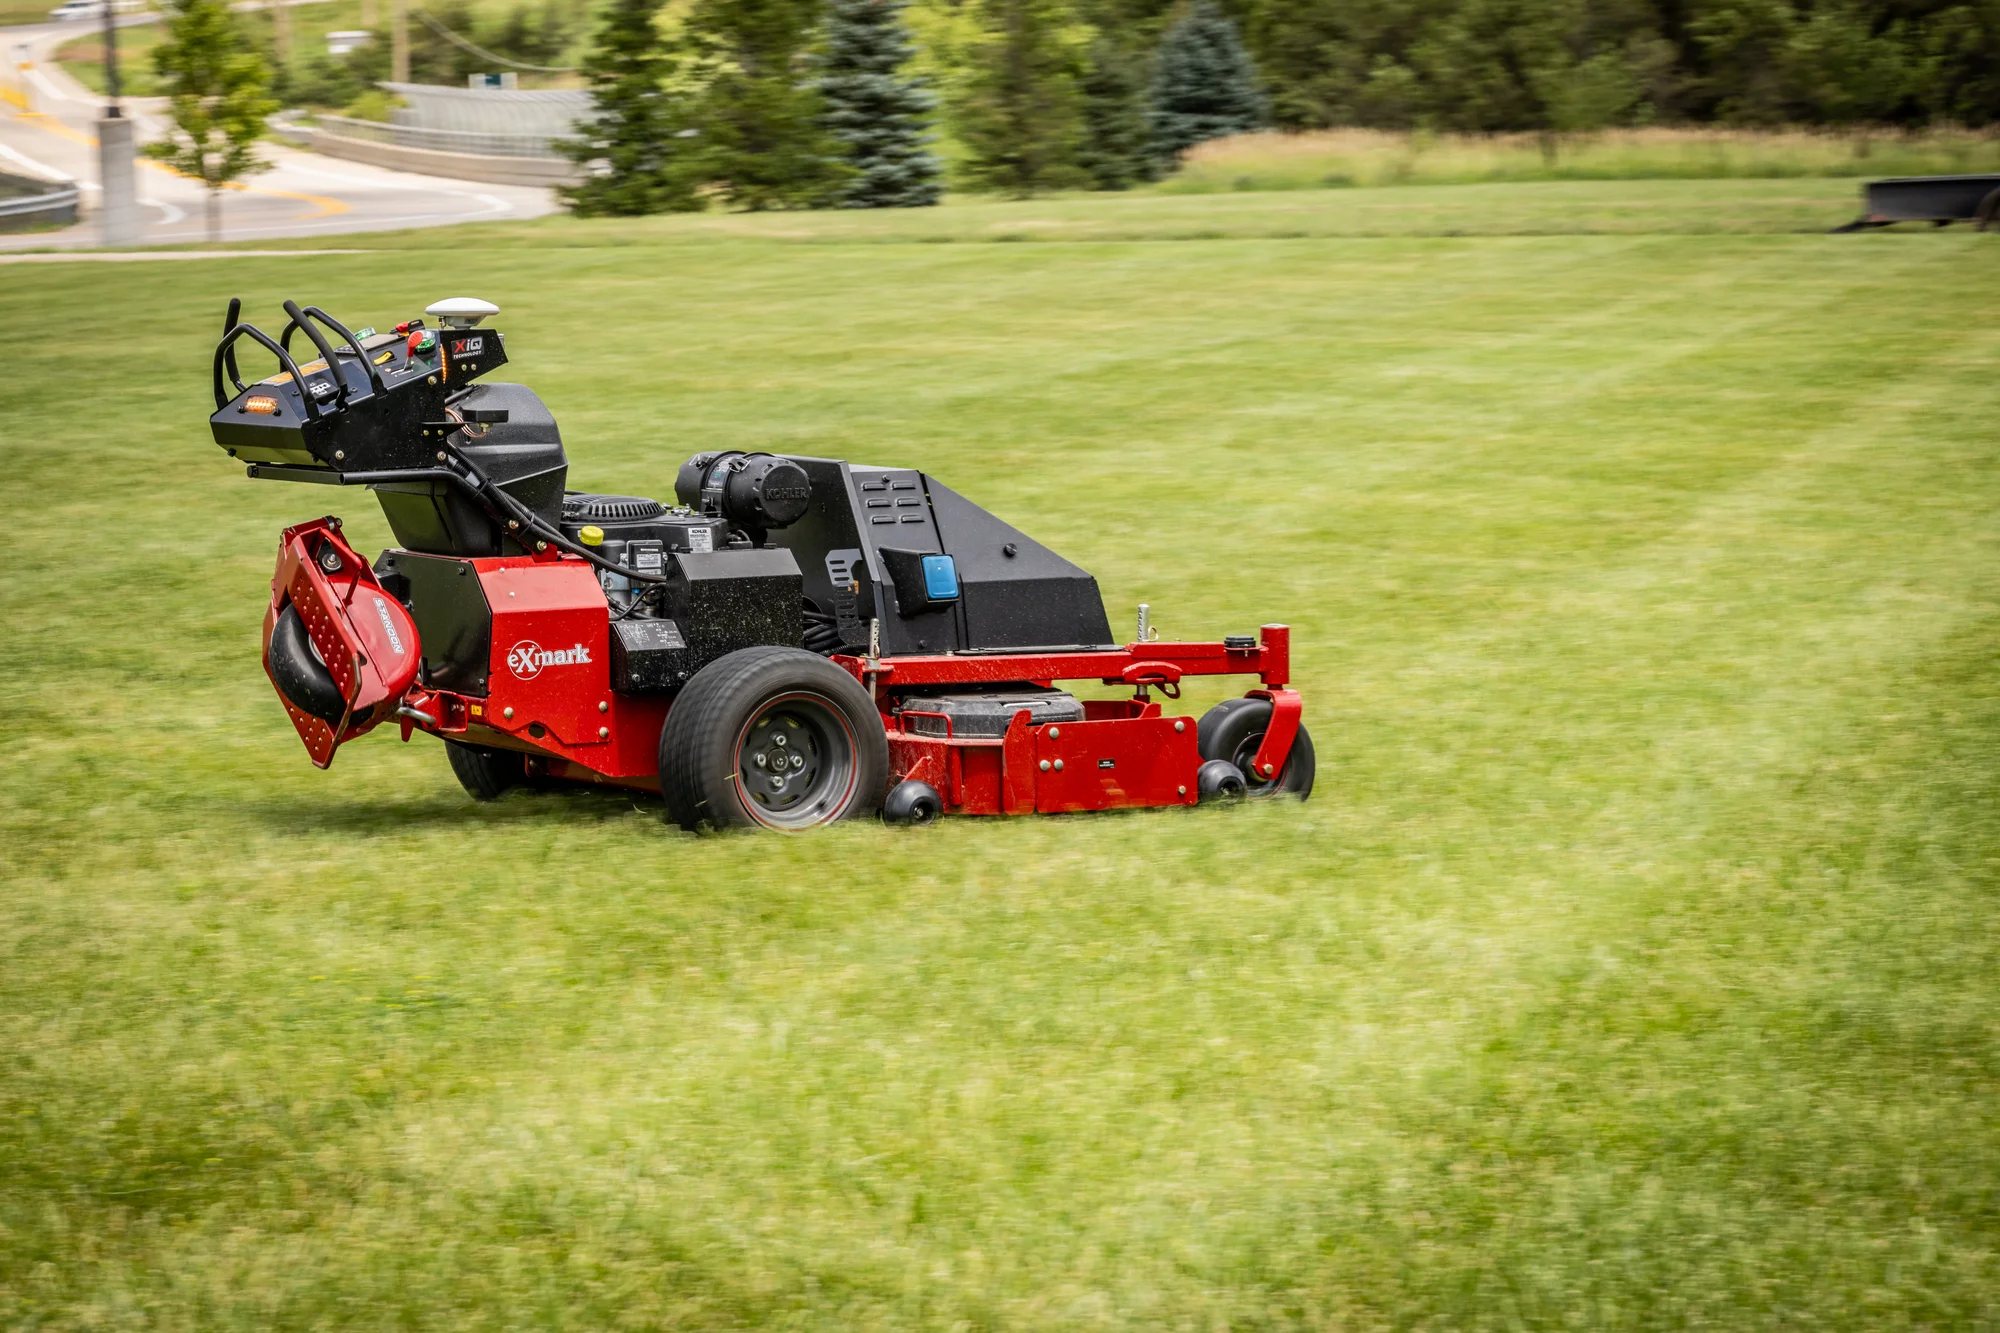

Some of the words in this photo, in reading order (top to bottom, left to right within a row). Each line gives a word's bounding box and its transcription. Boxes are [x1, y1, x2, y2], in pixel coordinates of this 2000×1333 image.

[453, 350, 482, 359] TECHNOLOGY
[766, 487, 809, 500] KOHLER
[507, 644, 592, 673] eXmark
